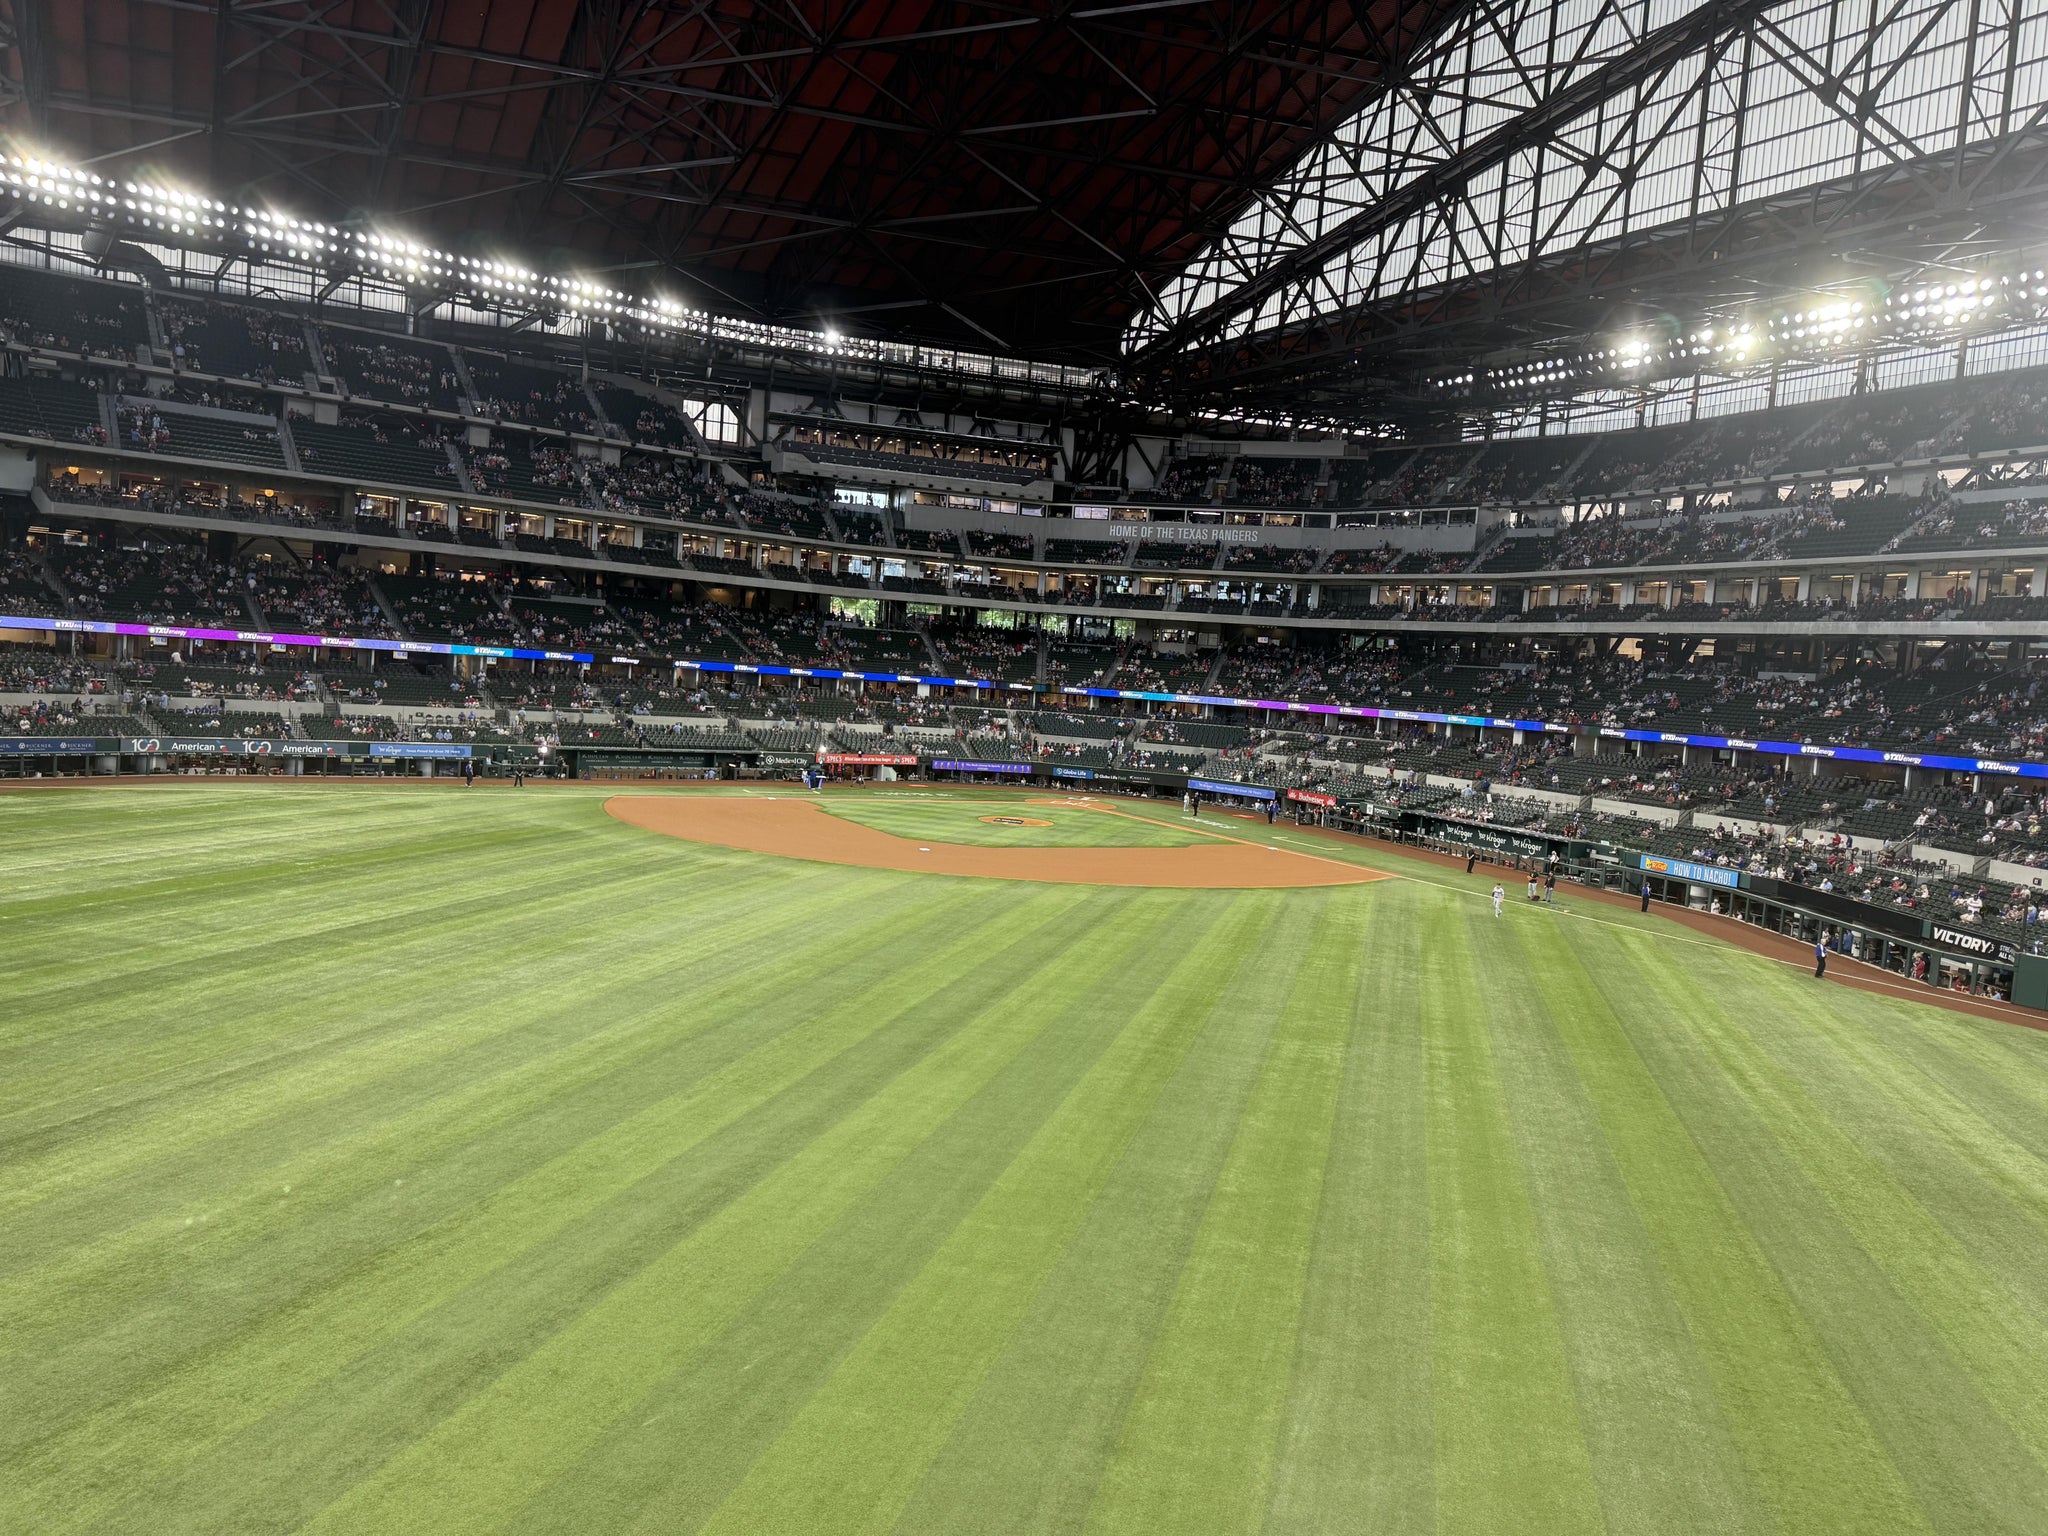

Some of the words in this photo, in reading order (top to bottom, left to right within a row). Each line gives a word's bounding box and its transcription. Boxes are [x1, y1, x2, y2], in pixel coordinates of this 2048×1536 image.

[1110, 525, 1138, 537] HOME
[1141, 526, 1153, 538] OF
[1156, 527, 1174, 539] THE
[1178, 528, 1208, 540] TEXAS
[1212, 529, 1258, 542] RANGERS
[172, 742, 215, 751] American
[282, 745, 322, 754] American
[1299, 793, 1324, 804] Budweiser
[1454, 826, 1473, 842] Kroger
[1486, 832, 1506, 848] Kroger
[1520, 839, 1542, 855] Kroger
[1674, 863, 1690, 877] HOW
[1693, 866, 1701, 878] TO
[1704, 869, 1731, 885] NACHO!
[1933, 927, 1991, 953] VICTORY
